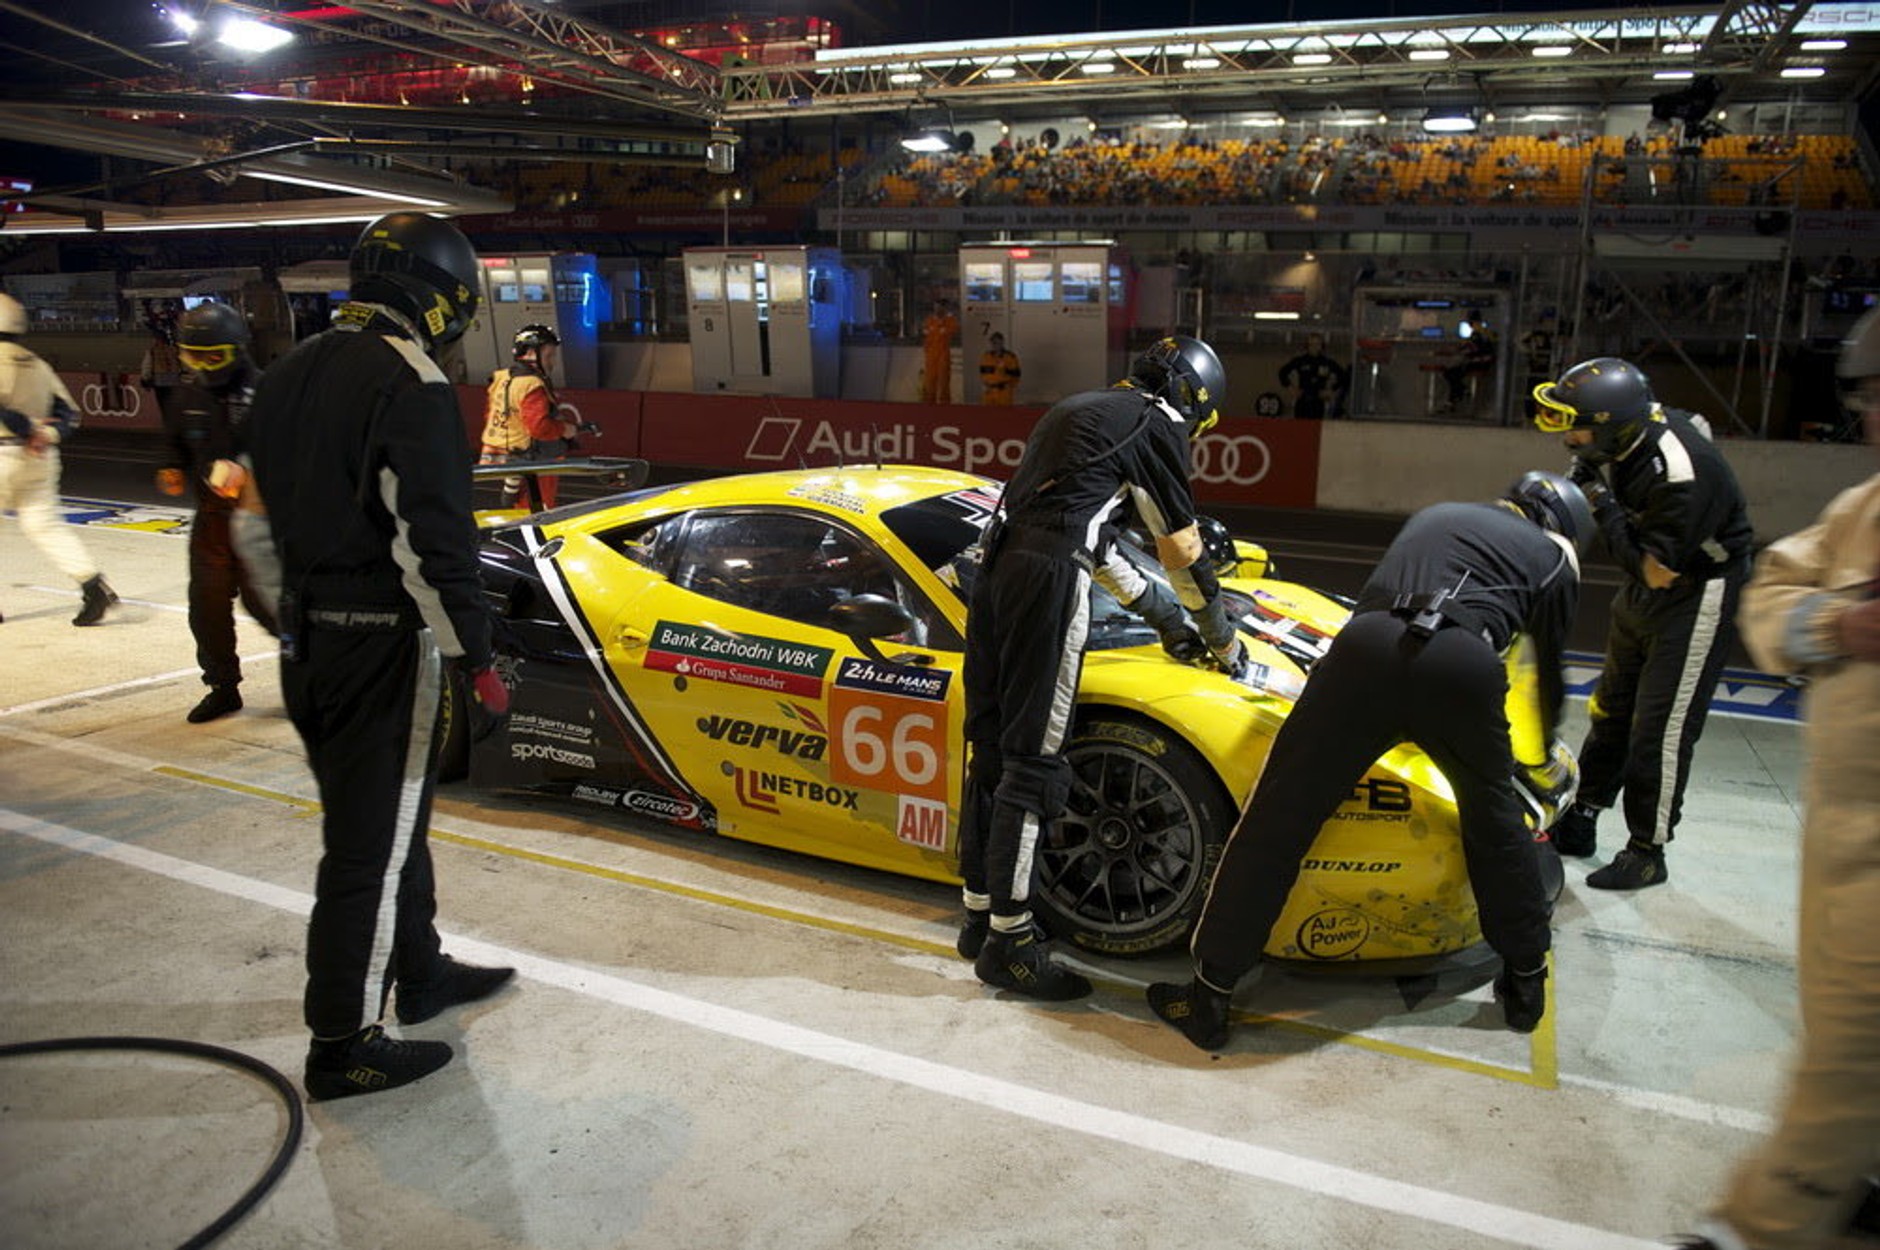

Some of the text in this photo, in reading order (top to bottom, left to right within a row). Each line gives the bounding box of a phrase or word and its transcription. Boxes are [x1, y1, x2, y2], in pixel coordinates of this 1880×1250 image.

[705, 318, 713, 331] 8
[981, 321, 990, 335] 7
[806, 420, 1027, 473] Audi Spo
[661, 629, 819, 669] Bank Zachodni WBK
[692, 662, 787, 690] Grupa Santander
[876, 673, 897, 684] LE
[896, 676, 942, 691] MANS
[708, 715, 828, 761] verva
[842, 705, 938, 786] 66
[761, 772, 859, 811] NETBOX
[632, 795, 690, 816] zircotec
[899, 804, 943, 847] AM
[1304, 859, 1402, 873] DUNLOP
[1311, 917, 1337, 932] AJ
[1311, 928, 1362, 950] Power
